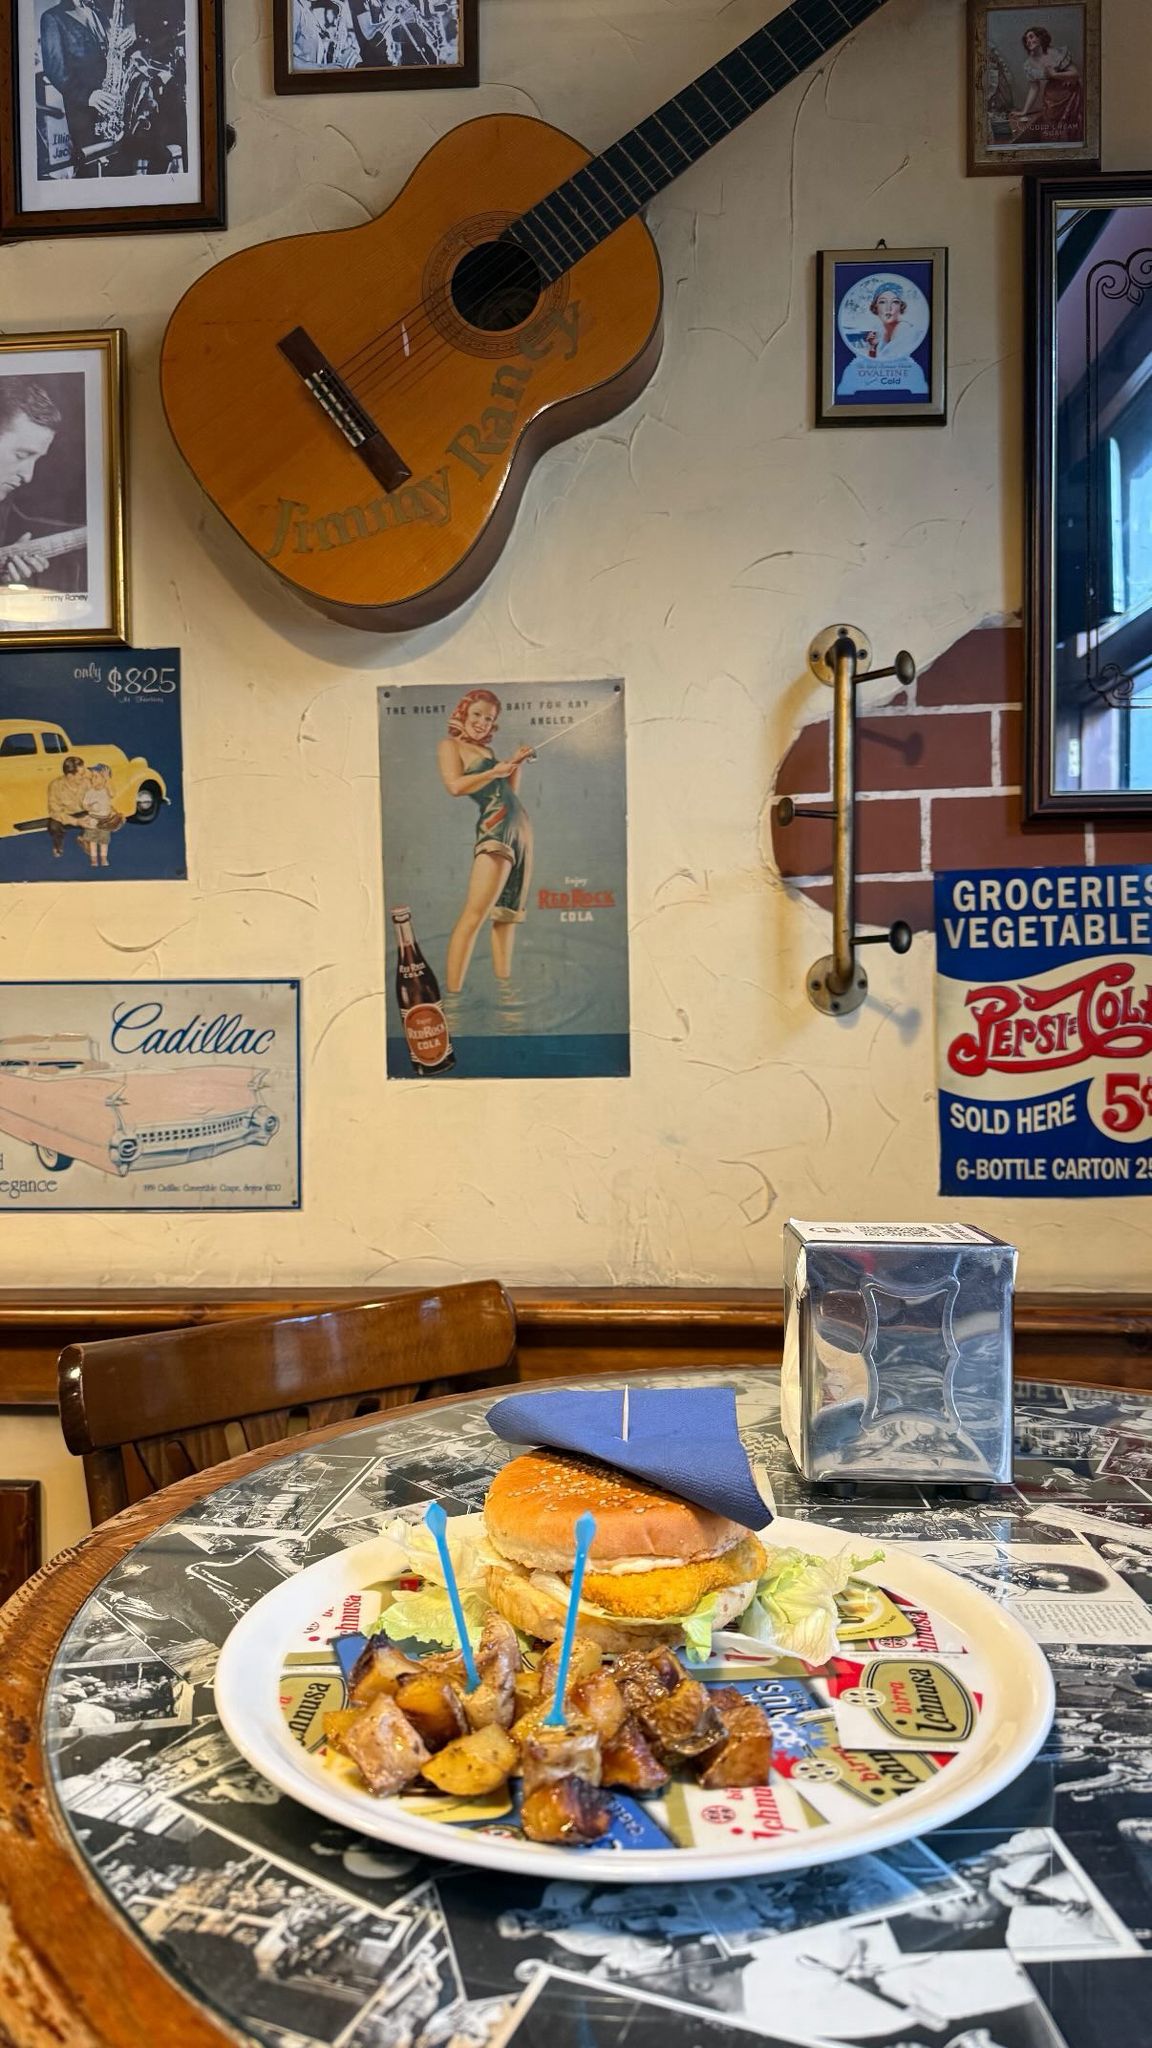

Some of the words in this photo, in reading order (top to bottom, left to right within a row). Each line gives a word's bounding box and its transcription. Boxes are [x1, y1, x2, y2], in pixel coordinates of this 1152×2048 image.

[857, 368, 909, 377] OVALTINE
[880, 377, 901, 385] Cold
[264, 466, 450, 559] Jimmy
[446, 301, 581, 482] Raney
[74, 662, 101, 683] only
[107, 667, 176, 697] $825
[386, 706, 406, 715] THE
[413, 705, 446, 715] RIGHT
[506, 701, 532, 711] BAIT
[539, 701, 562, 710] FOR
[530, 716, 574, 726] ANGLER
[560, 911, 594, 922] COLA
[943, 912, 1151, 949] VEGETABLE
[111, 1001, 276, 1055] Cadillac
[417, 1039, 441, 1050] COLA
[950, 1102, 1010, 1135] SOLD
[1017, 1094, 1077, 1135] HERE
[956, 1158, 1047, 1181] 6-BOTTLE
[1052, 1157, 1130, 1180] CARTON
[889, 1680, 912, 1716] birra
